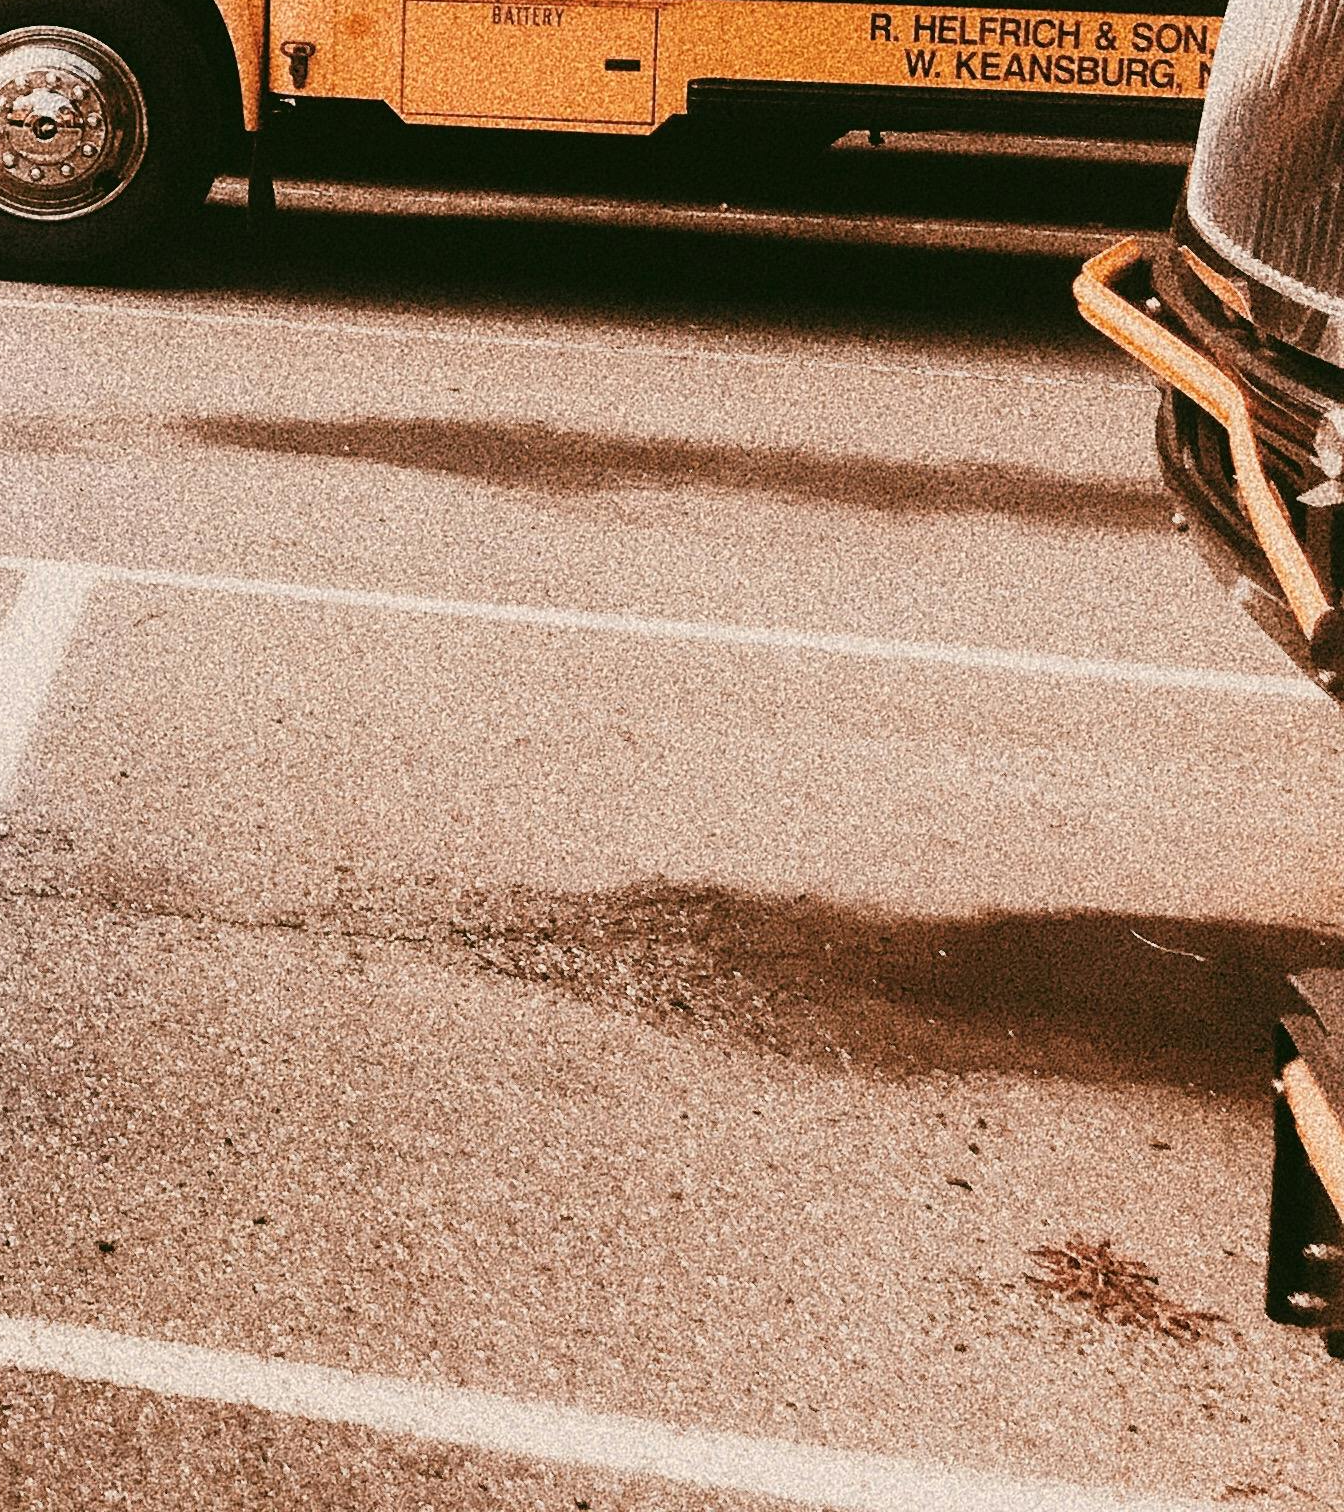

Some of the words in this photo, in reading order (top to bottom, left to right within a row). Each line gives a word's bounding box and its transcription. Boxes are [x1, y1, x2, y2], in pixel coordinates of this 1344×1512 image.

[492, 5, 565, 27] BATTERY
[870, 12, 900, 42] R.
[913, 14, 1081, 50] HELFRICH
[1094, 21, 1119, 51] &
[904, 48, 941, 79] W.
[955, 50, 1183, 95] KEANSBURG,
[1197, 60, 1211, 90] N
